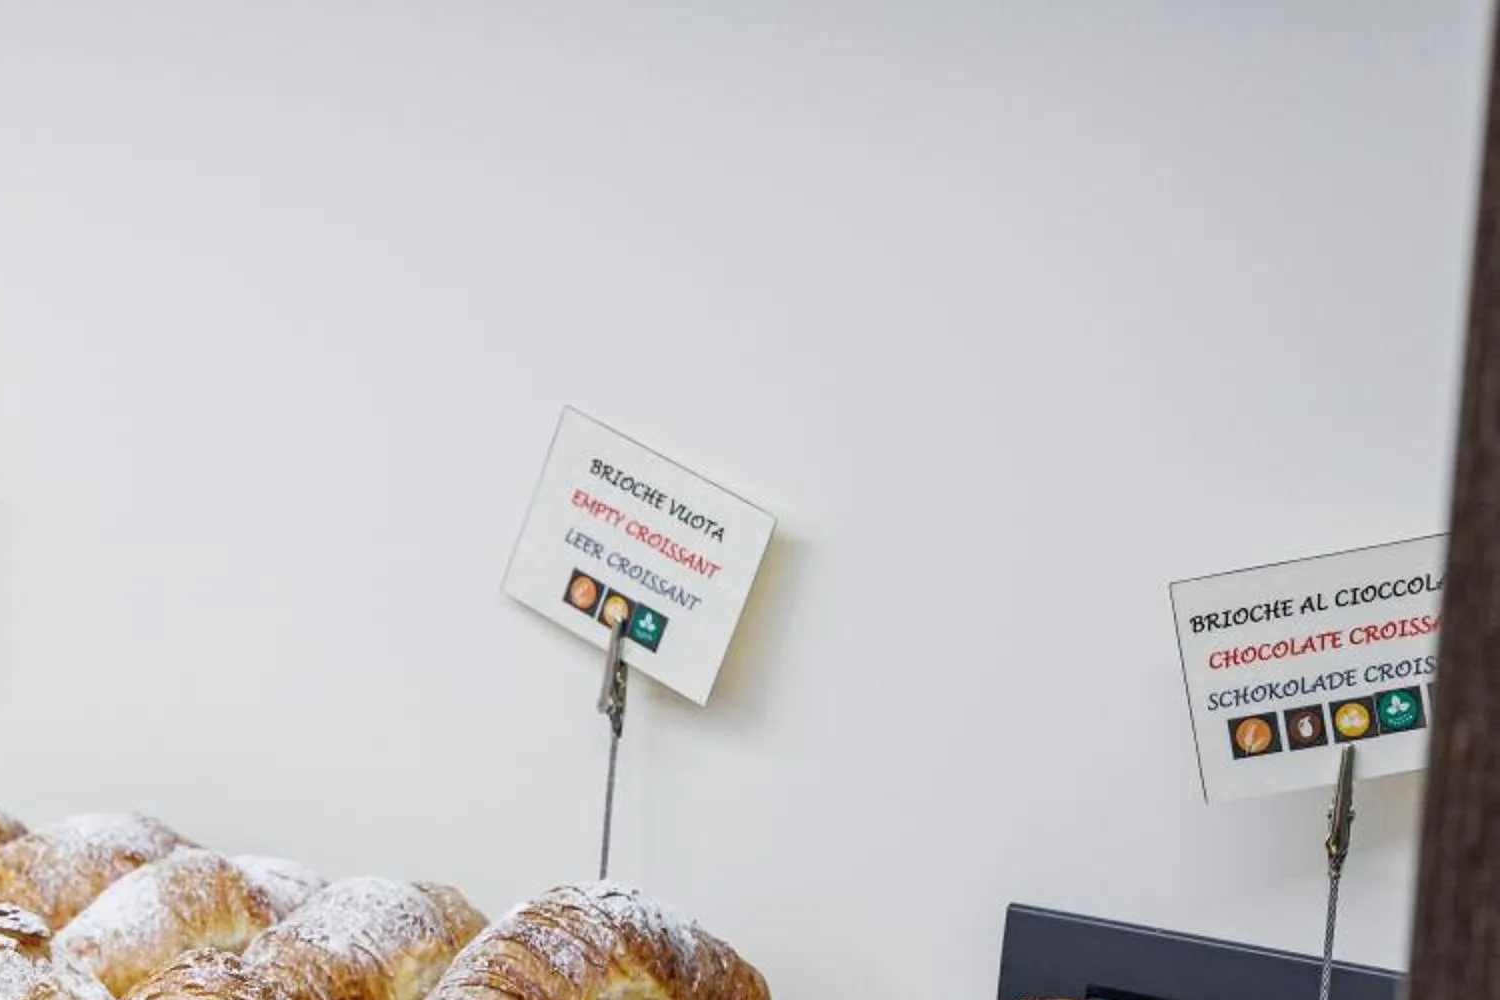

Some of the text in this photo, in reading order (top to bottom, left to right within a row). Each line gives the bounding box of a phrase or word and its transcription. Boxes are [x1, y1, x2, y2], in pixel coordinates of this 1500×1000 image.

[589, 457, 726, 545] BRIOCHE VUOTA
[571, 488, 723, 580] EMPTY CROISSANT
[564, 527, 703, 612] LEER CROISSANT
[1189, 599, 1294, 634] BRIOCHE
[1299, 593, 1329, 615] AL
[1208, 630, 1344, 671] CHOCOLATE
[1207, 668, 1357, 712] SCHOKOLADE
